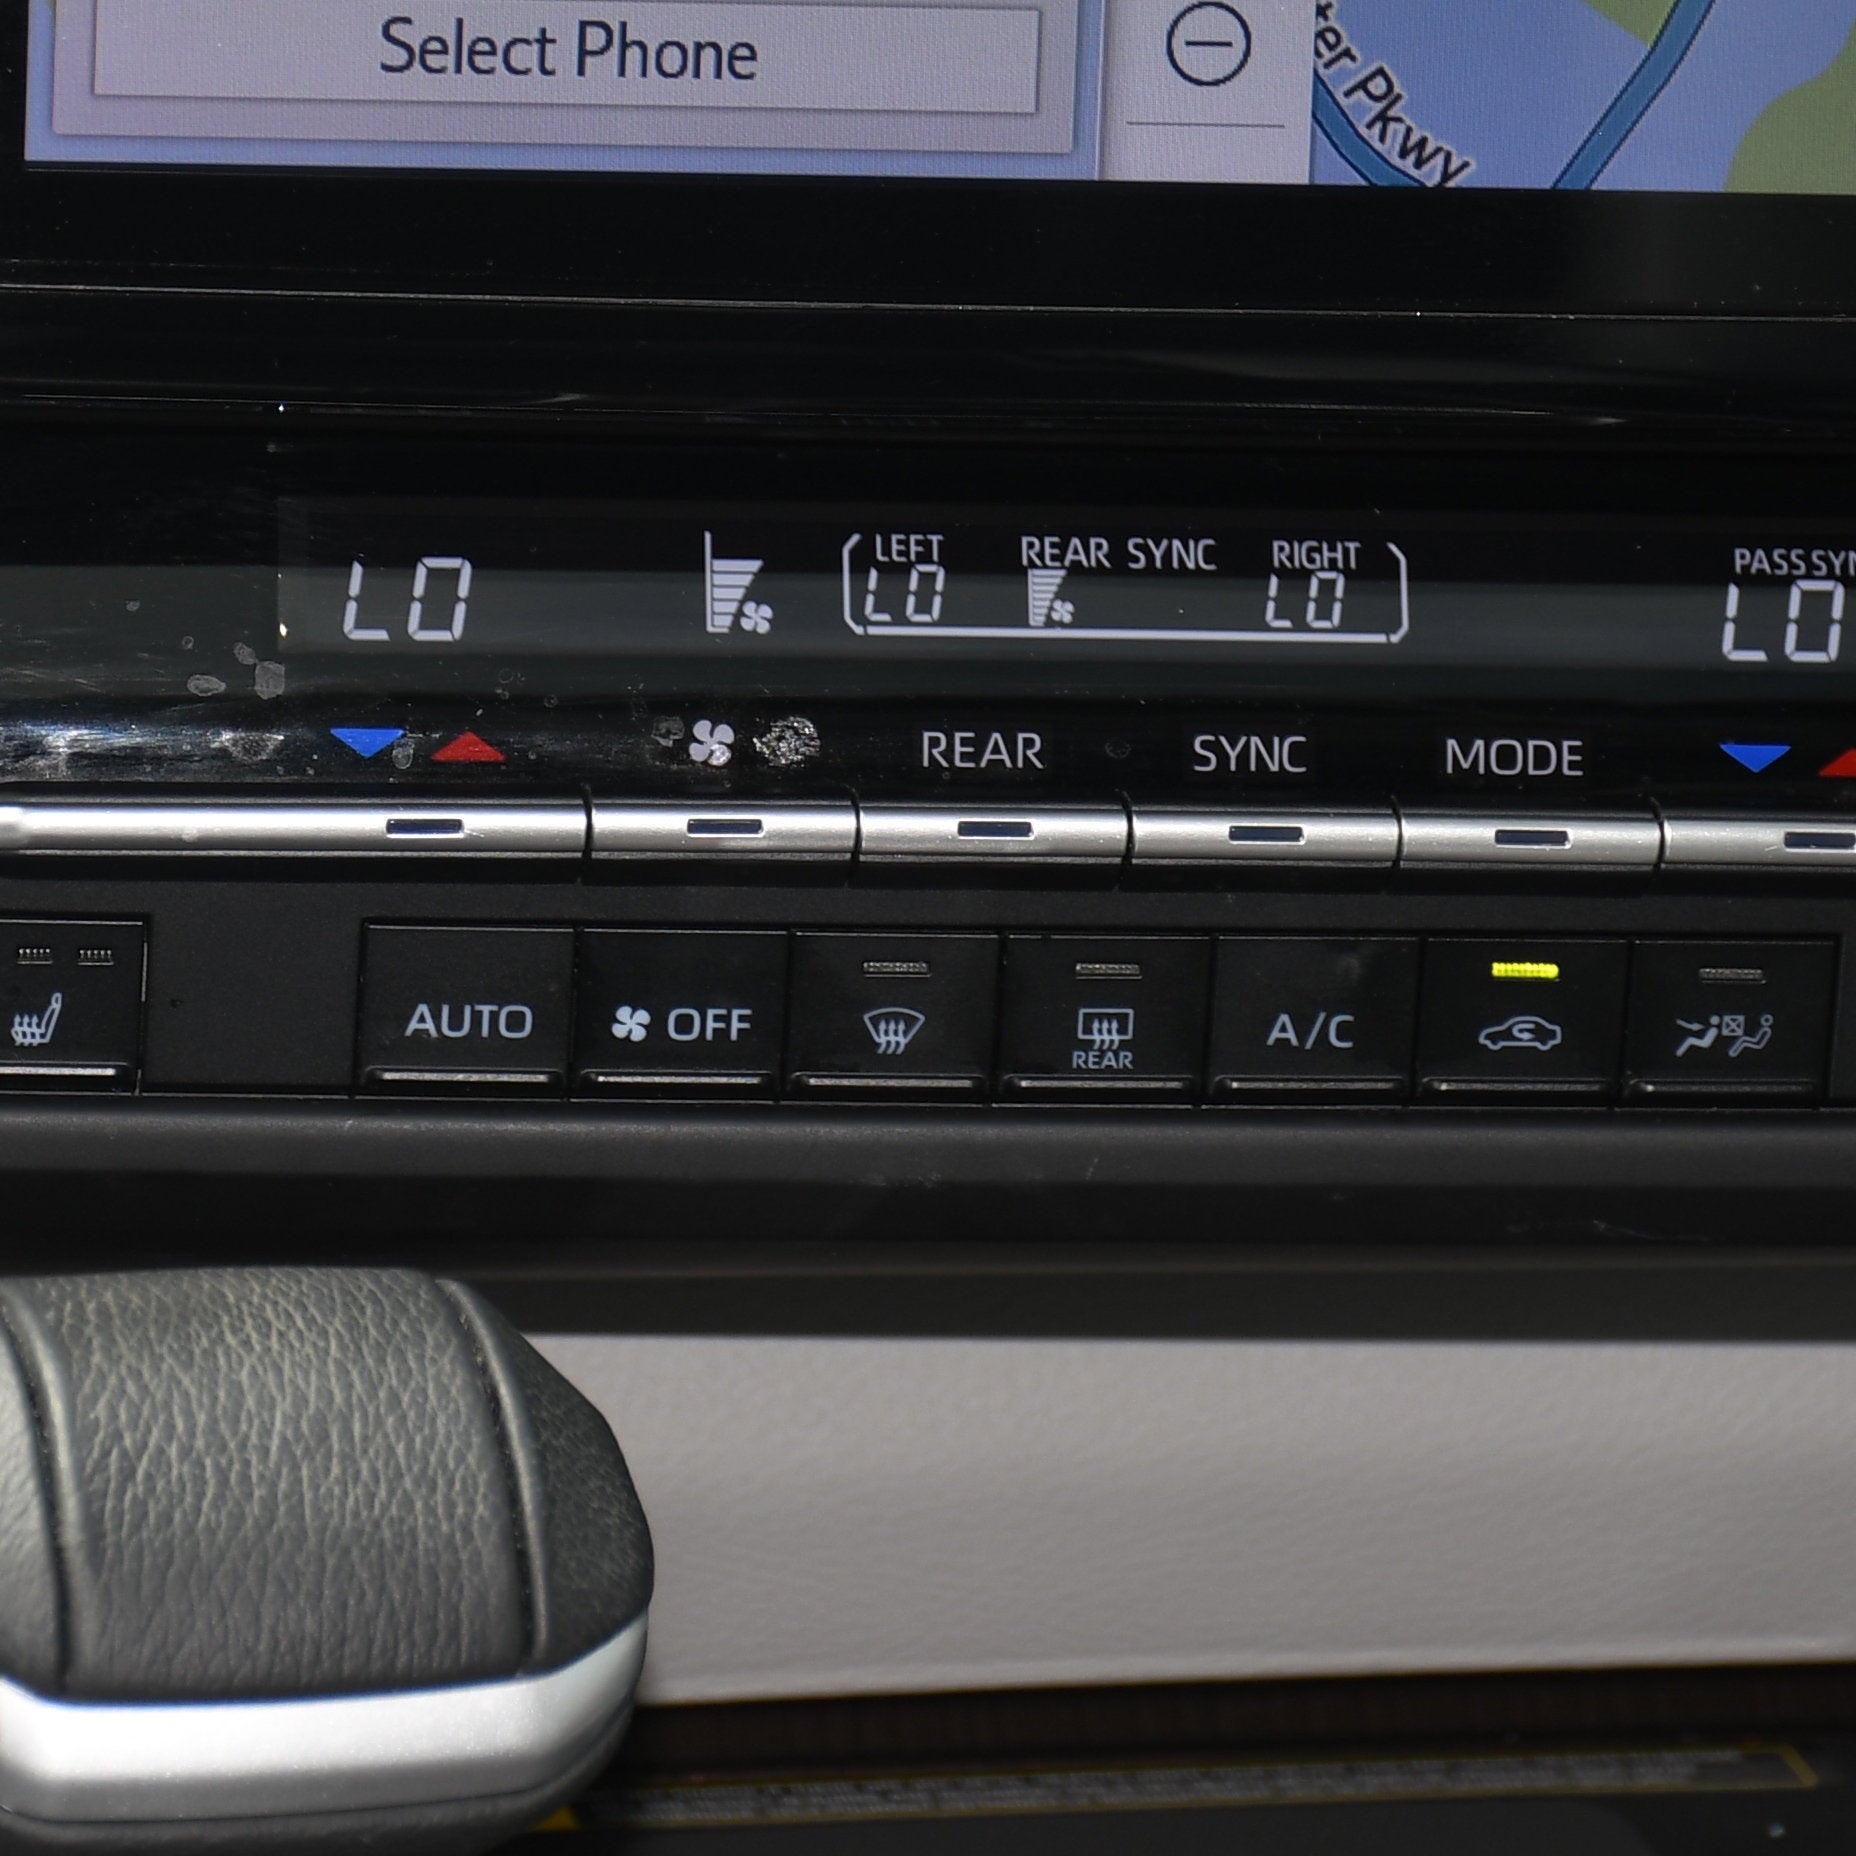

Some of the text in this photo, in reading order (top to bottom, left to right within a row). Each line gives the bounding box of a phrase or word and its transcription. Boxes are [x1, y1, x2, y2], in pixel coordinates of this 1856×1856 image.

[381, 16, 757, 80] Select Phone
[1343, 65, 1472, 188] Pkwy
[876, 534, 943, 562] LEFT
[1022, 537, 1216, 569] REAR SYNC
[1273, 541, 1360, 569] RIGHT
[1735, 548, 1805, 575] PASS
[923, 732, 1043, 768] REAR
[1194, 735, 1306, 772] SYNC
[1447, 739, 1582, 775] MODE
[406, 1004, 532, 1038] AUTO
[668, 1008, 751, 1040] OFF
[1267, 1013, 1353, 1049] A/C
[1073, 1051, 1132, 1068] REAR
